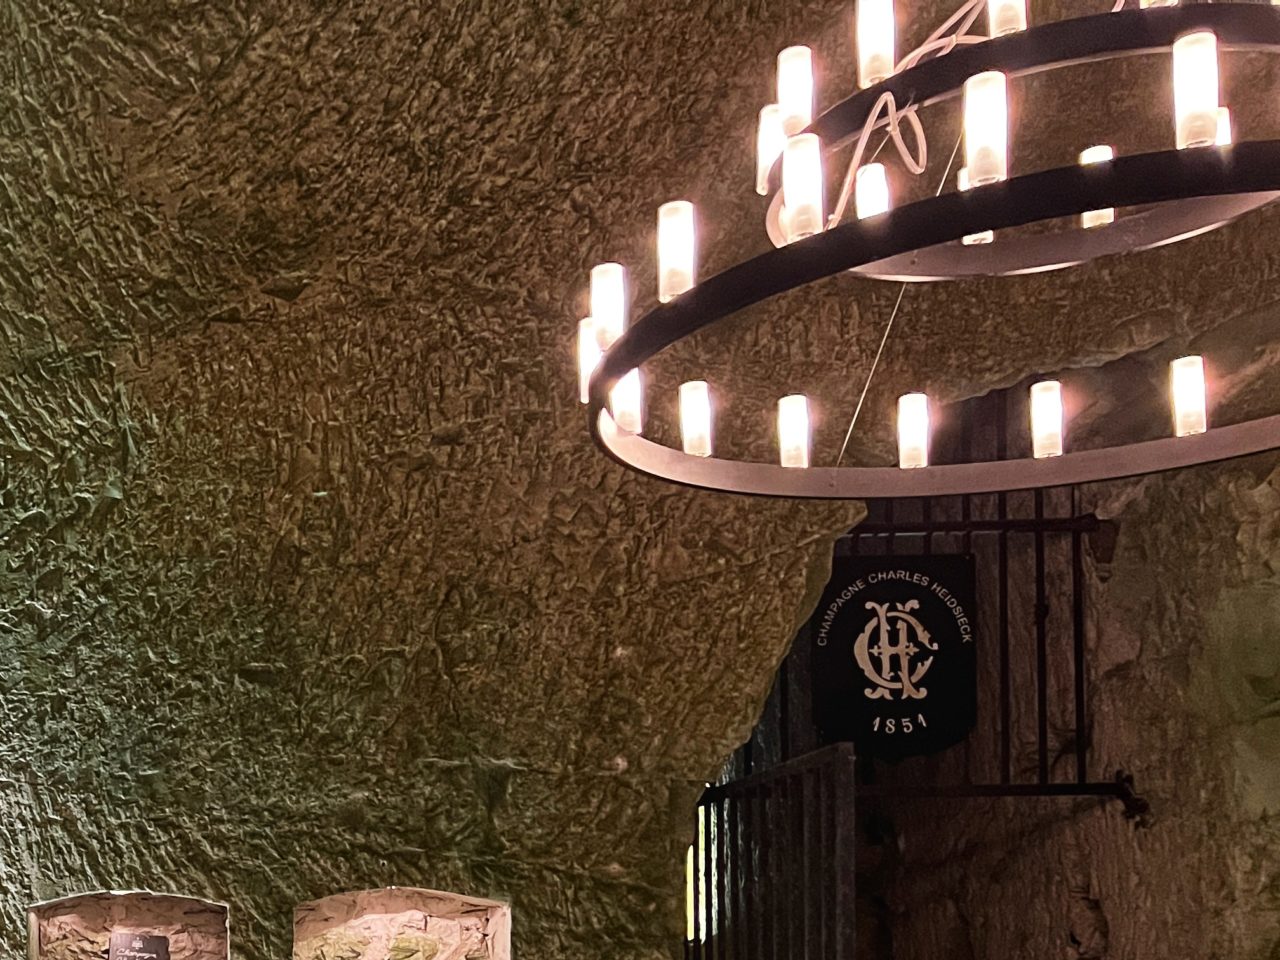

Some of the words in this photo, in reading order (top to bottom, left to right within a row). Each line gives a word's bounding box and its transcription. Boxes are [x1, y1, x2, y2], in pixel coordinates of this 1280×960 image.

[817, 578, 866, 647] CHAMPAGNE
[868, 570, 930, 586] CHARLES
[930, 583, 973, 643] HEIDSIECK
[872, 713, 927, 734] 1851
